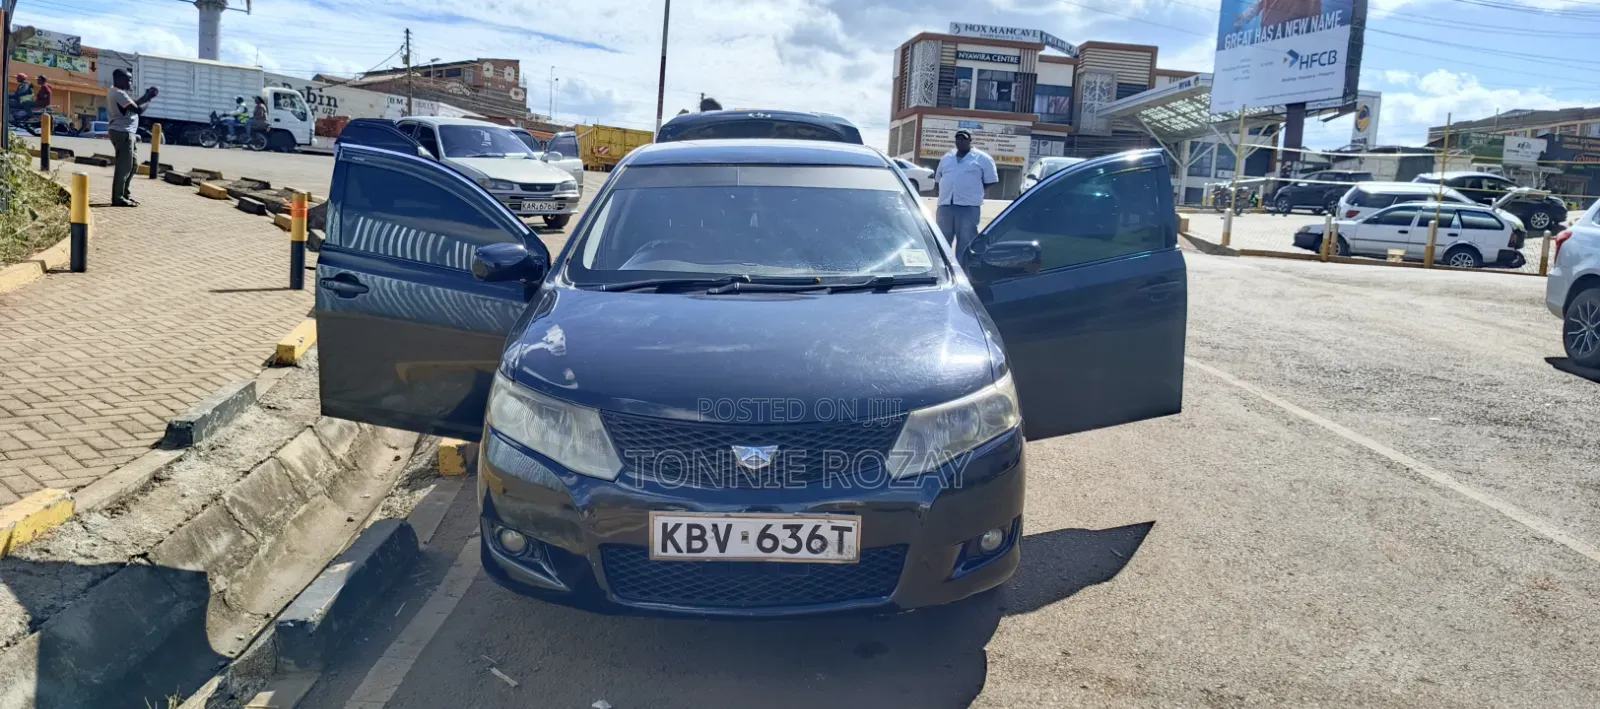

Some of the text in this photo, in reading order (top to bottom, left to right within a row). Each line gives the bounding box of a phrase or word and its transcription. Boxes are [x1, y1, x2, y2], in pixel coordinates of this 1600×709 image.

[964, 23, 1039, 38] NOX MANCAVE
[1224, 10, 1343, 50] GREAT HAS A NEW NAME
[958, 52, 1019, 63] NYAWIRA CENTRE
[1299, 50, 1338, 69] HFCB
[282, 82, 338, 108] bin
[522, 202, 536, 210] KAR
[660, 522, 852, 555] KBV 636T
